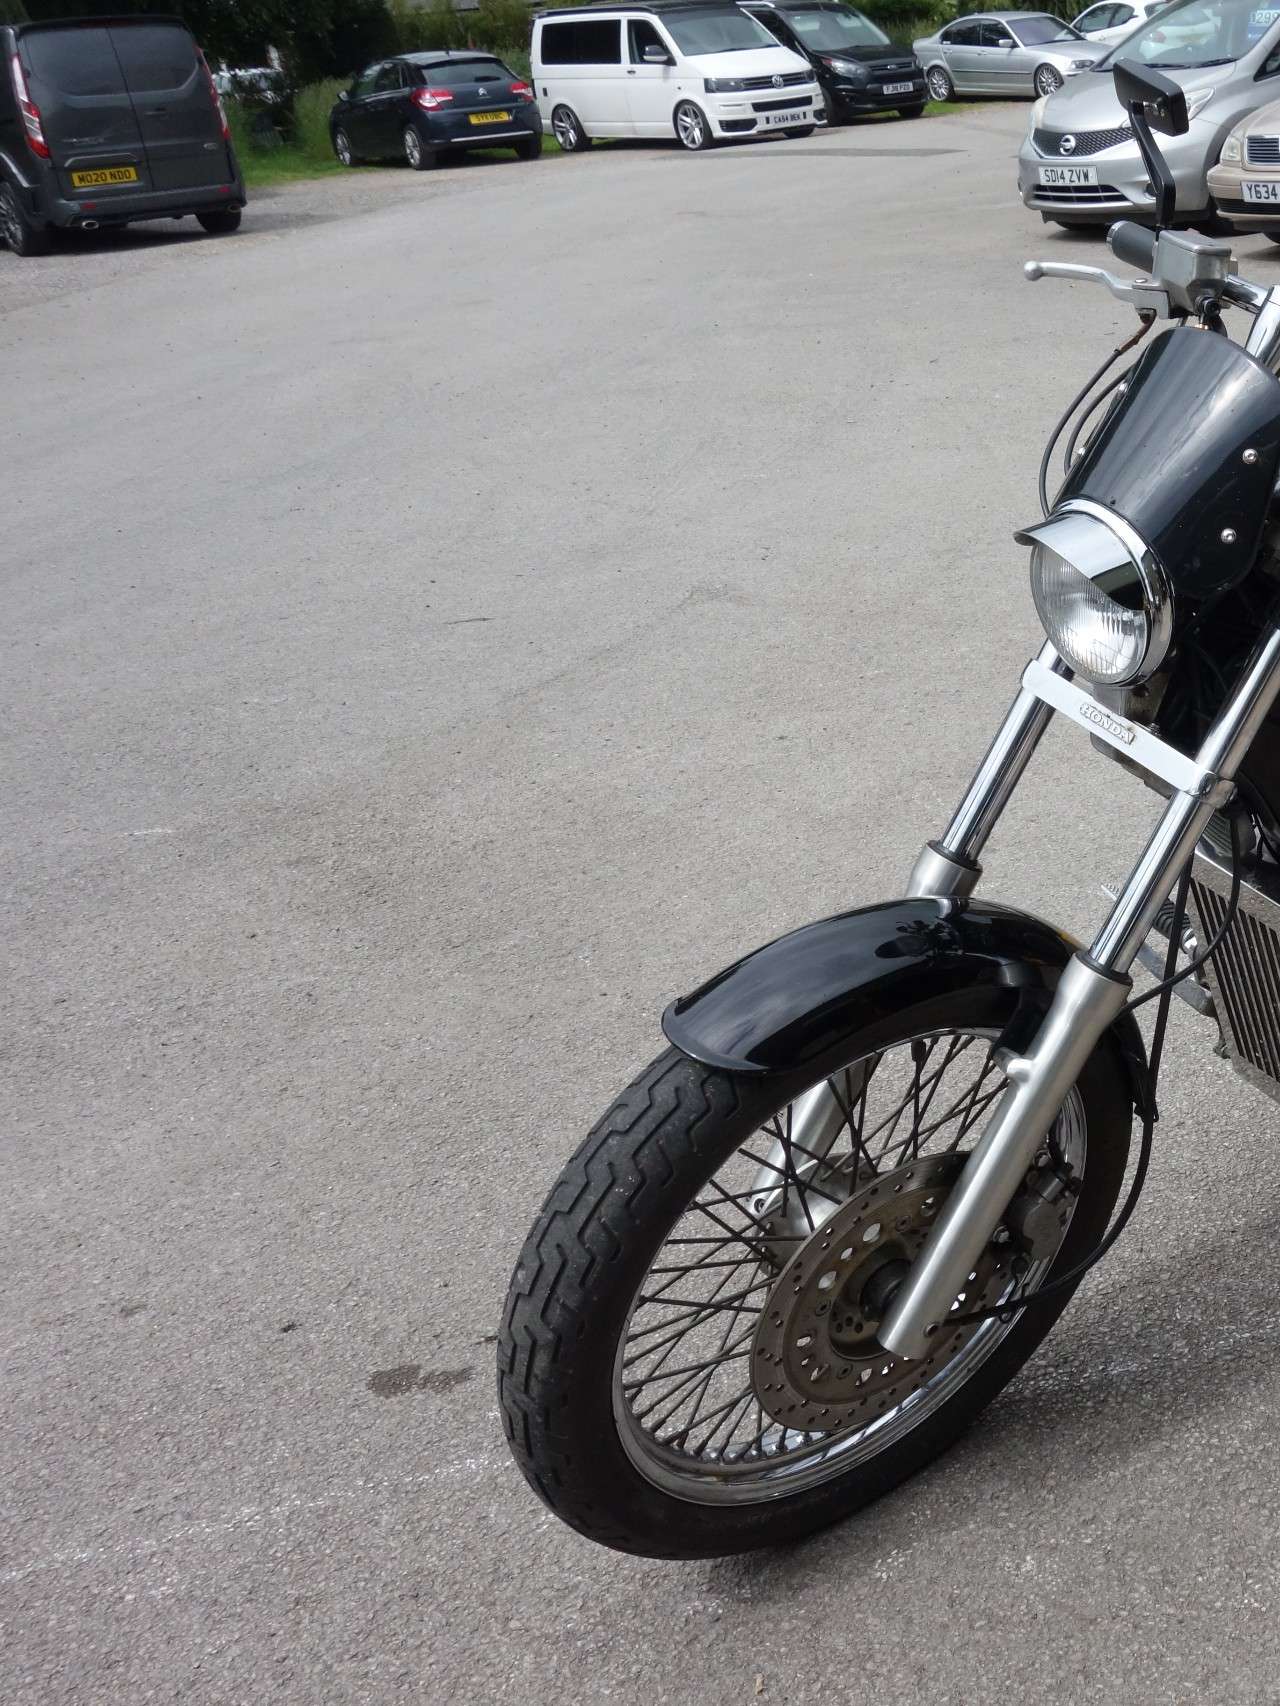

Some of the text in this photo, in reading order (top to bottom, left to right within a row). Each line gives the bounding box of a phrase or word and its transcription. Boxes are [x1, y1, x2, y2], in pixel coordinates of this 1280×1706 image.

[1044, 169, 1090, 183] SD14 ZVW
[1246, 183, 1278, 200] Y634
[1080, 703, 1133, 745] HONDA
